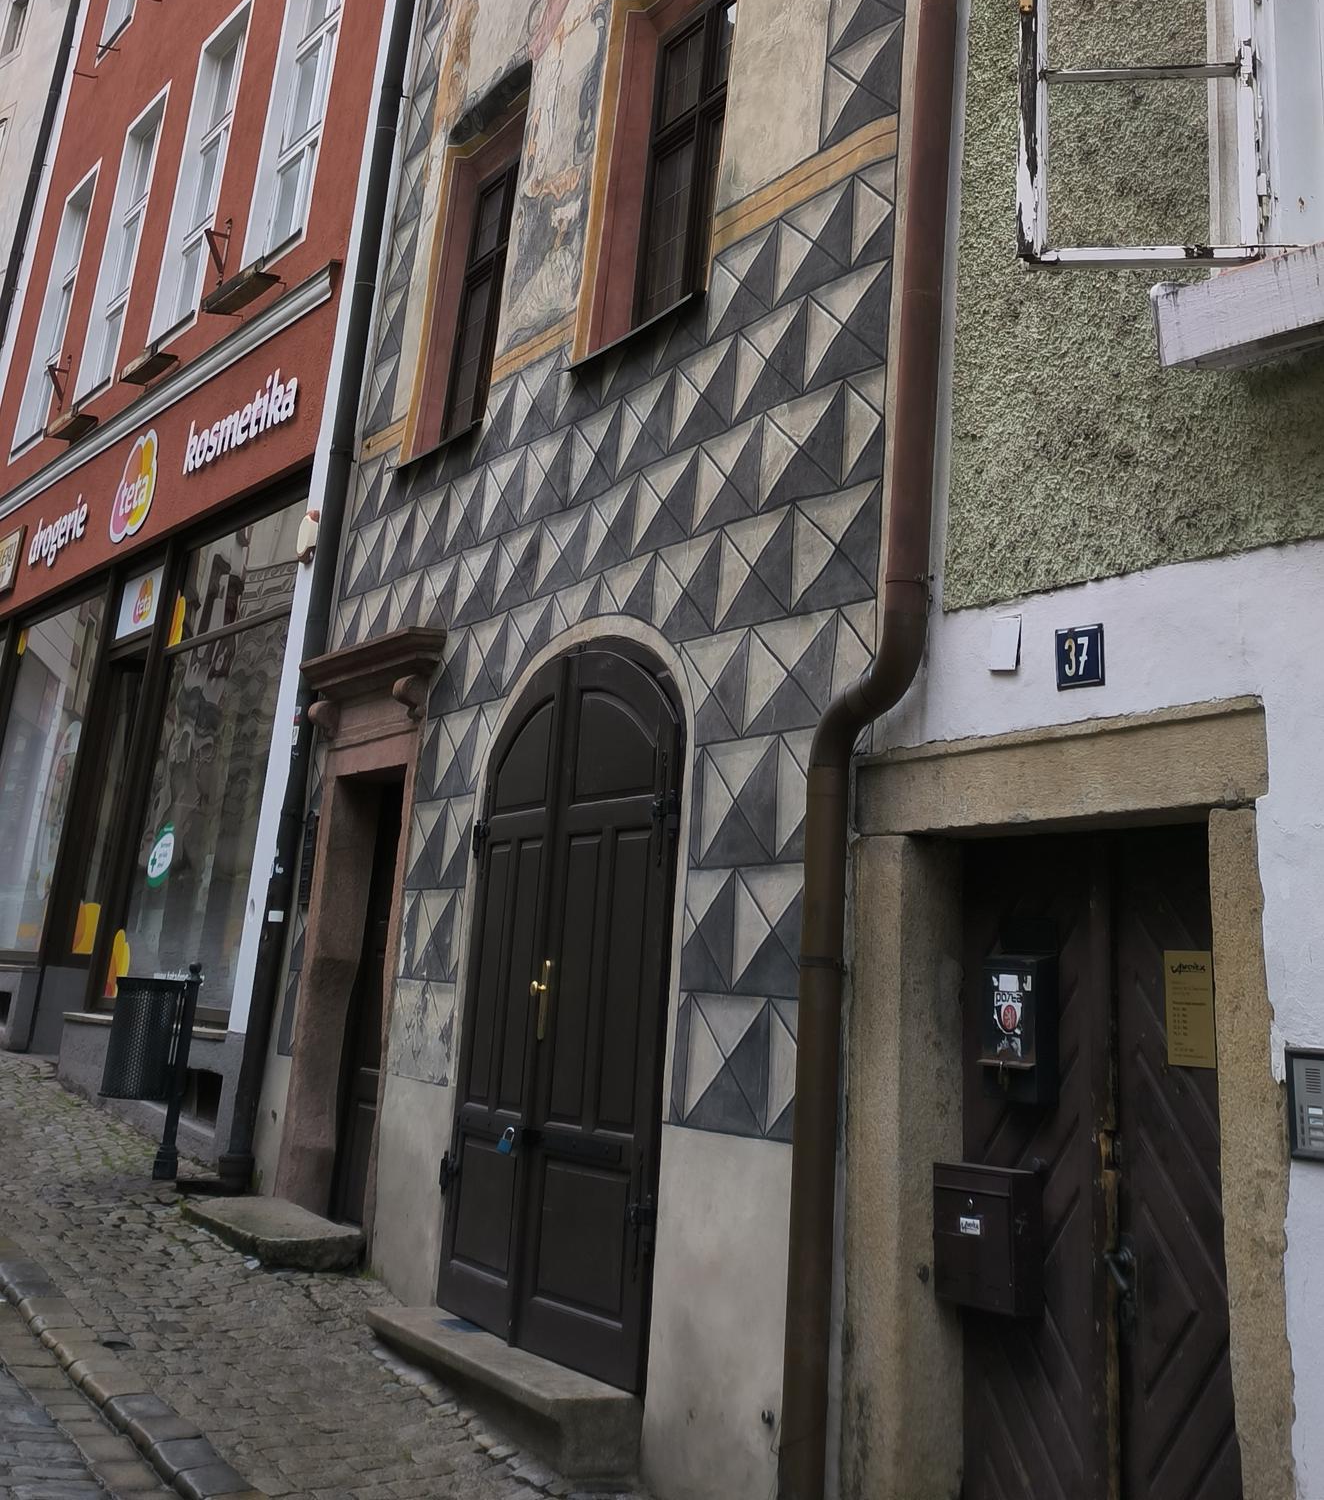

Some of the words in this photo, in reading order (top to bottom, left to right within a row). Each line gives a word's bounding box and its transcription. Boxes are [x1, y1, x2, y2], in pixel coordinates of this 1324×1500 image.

[182, 368, 298, 476] kosmetika
[119, 473, 149, 517] teta
[27, 493, 88, 568] drogerie
[1064, 636, 1089, 677] 37
